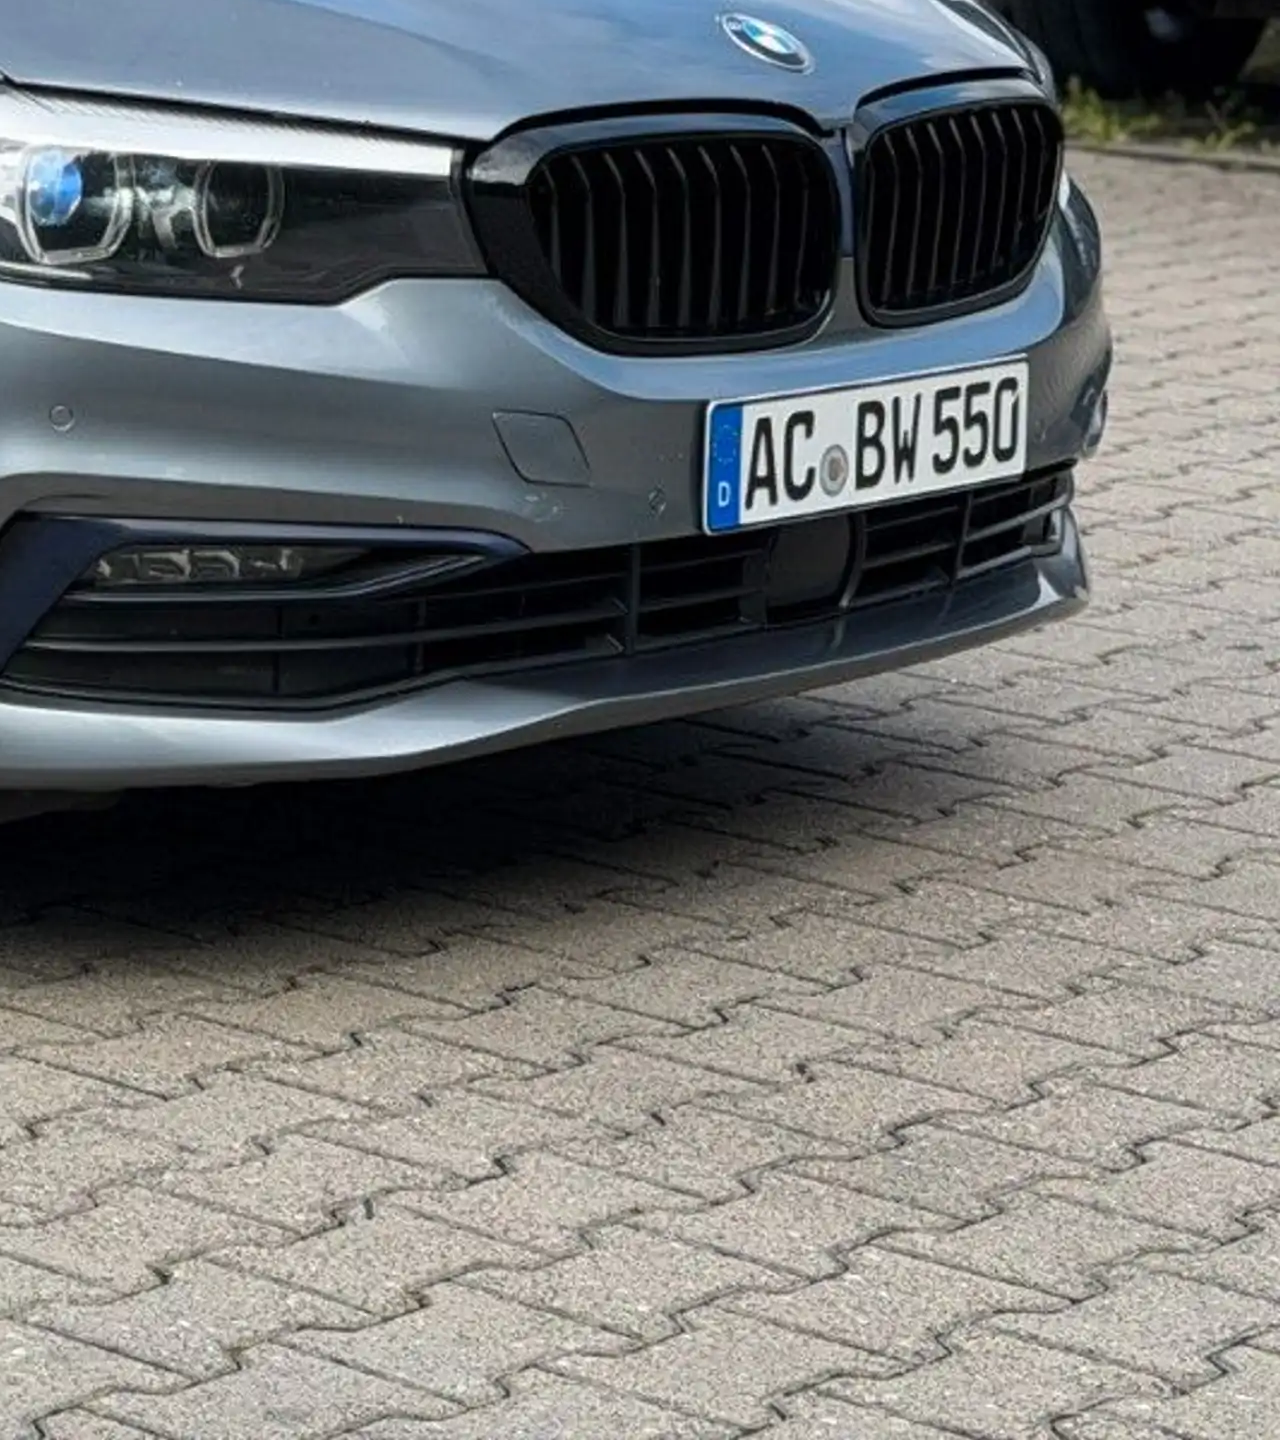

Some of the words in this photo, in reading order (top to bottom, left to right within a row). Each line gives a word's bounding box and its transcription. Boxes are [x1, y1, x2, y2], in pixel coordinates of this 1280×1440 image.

[746, 412, 814, 510] AC
[855, 394, 922, 491] BW
[932, 377, 1019, 474] 550
[717, 481, 731, 508] D
